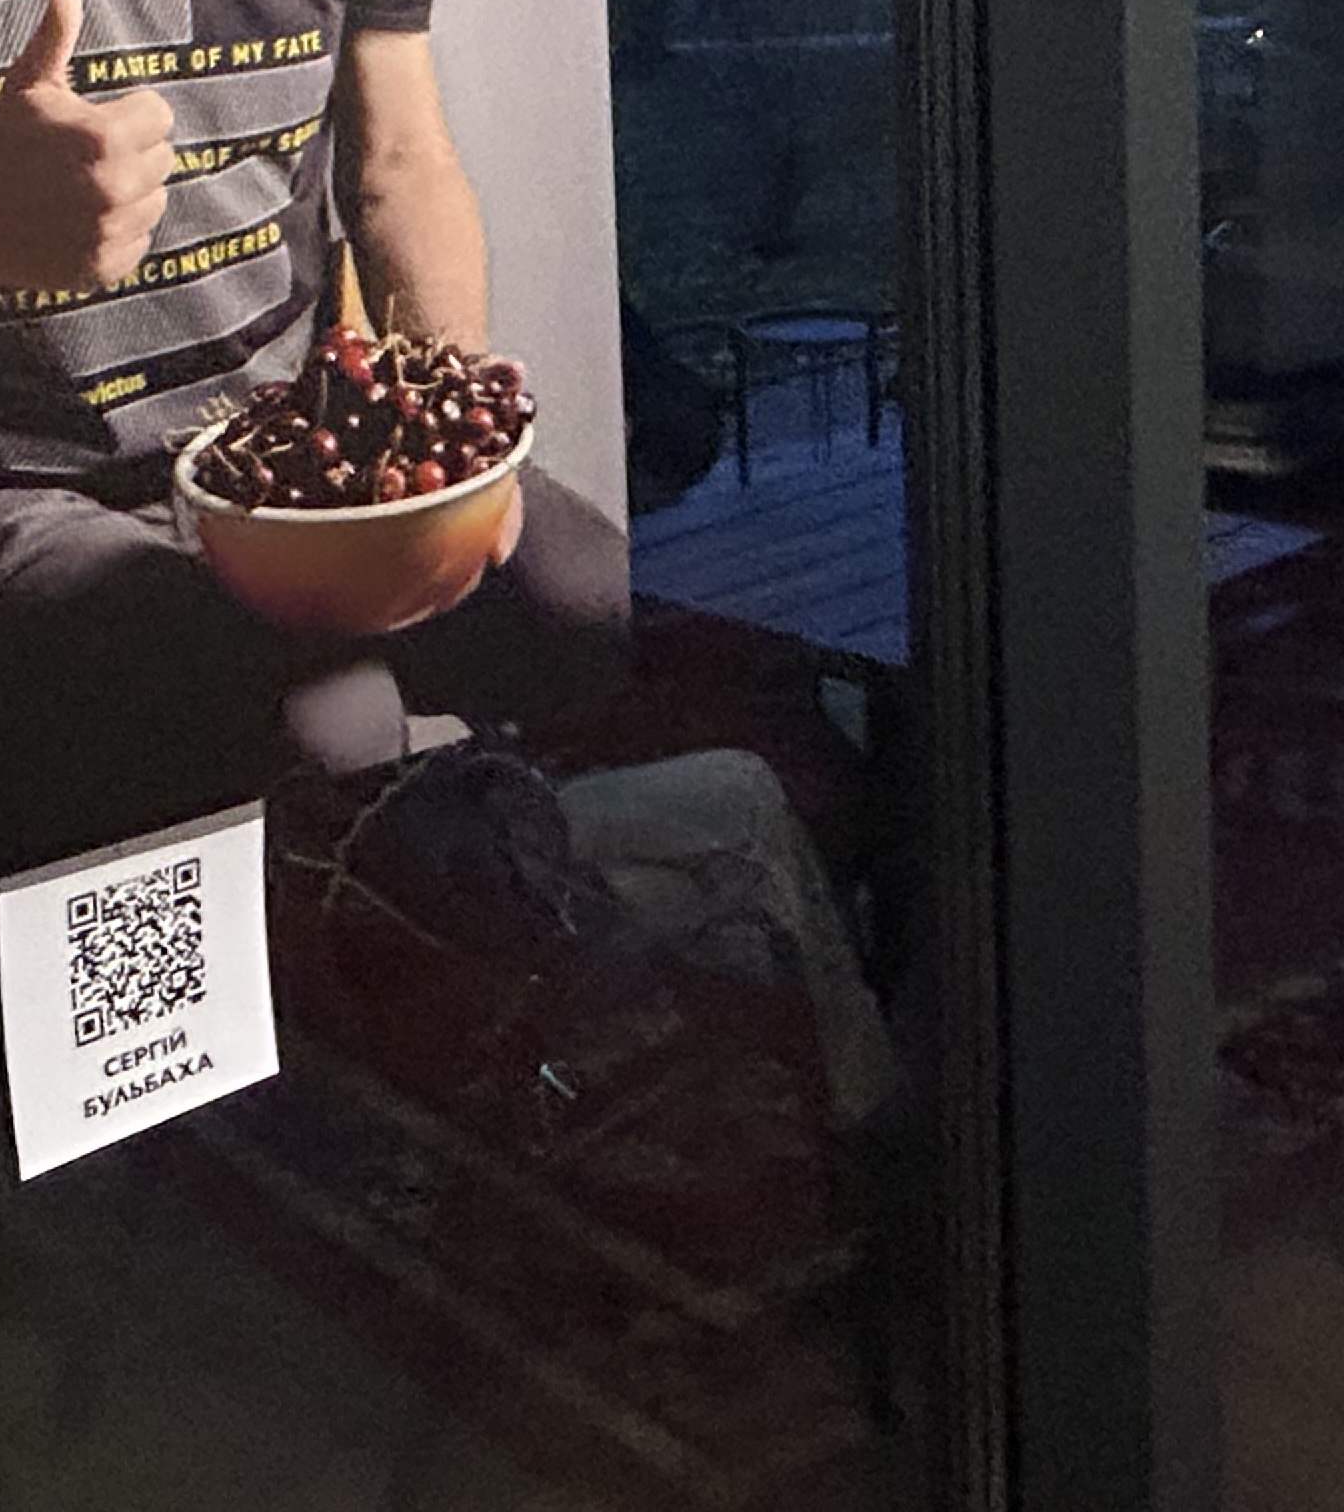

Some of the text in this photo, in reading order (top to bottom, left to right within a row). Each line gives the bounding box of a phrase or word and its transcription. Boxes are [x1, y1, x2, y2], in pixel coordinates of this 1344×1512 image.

[190, 47, 222, 70] OF
[232, 40, 265, 65] MY
[274, 29, 321, 59] FATE
[103, 1026, 188, 1078] СЕРГІЙ
[82, 1052, 214, 1119] БУЛЬБАХА
